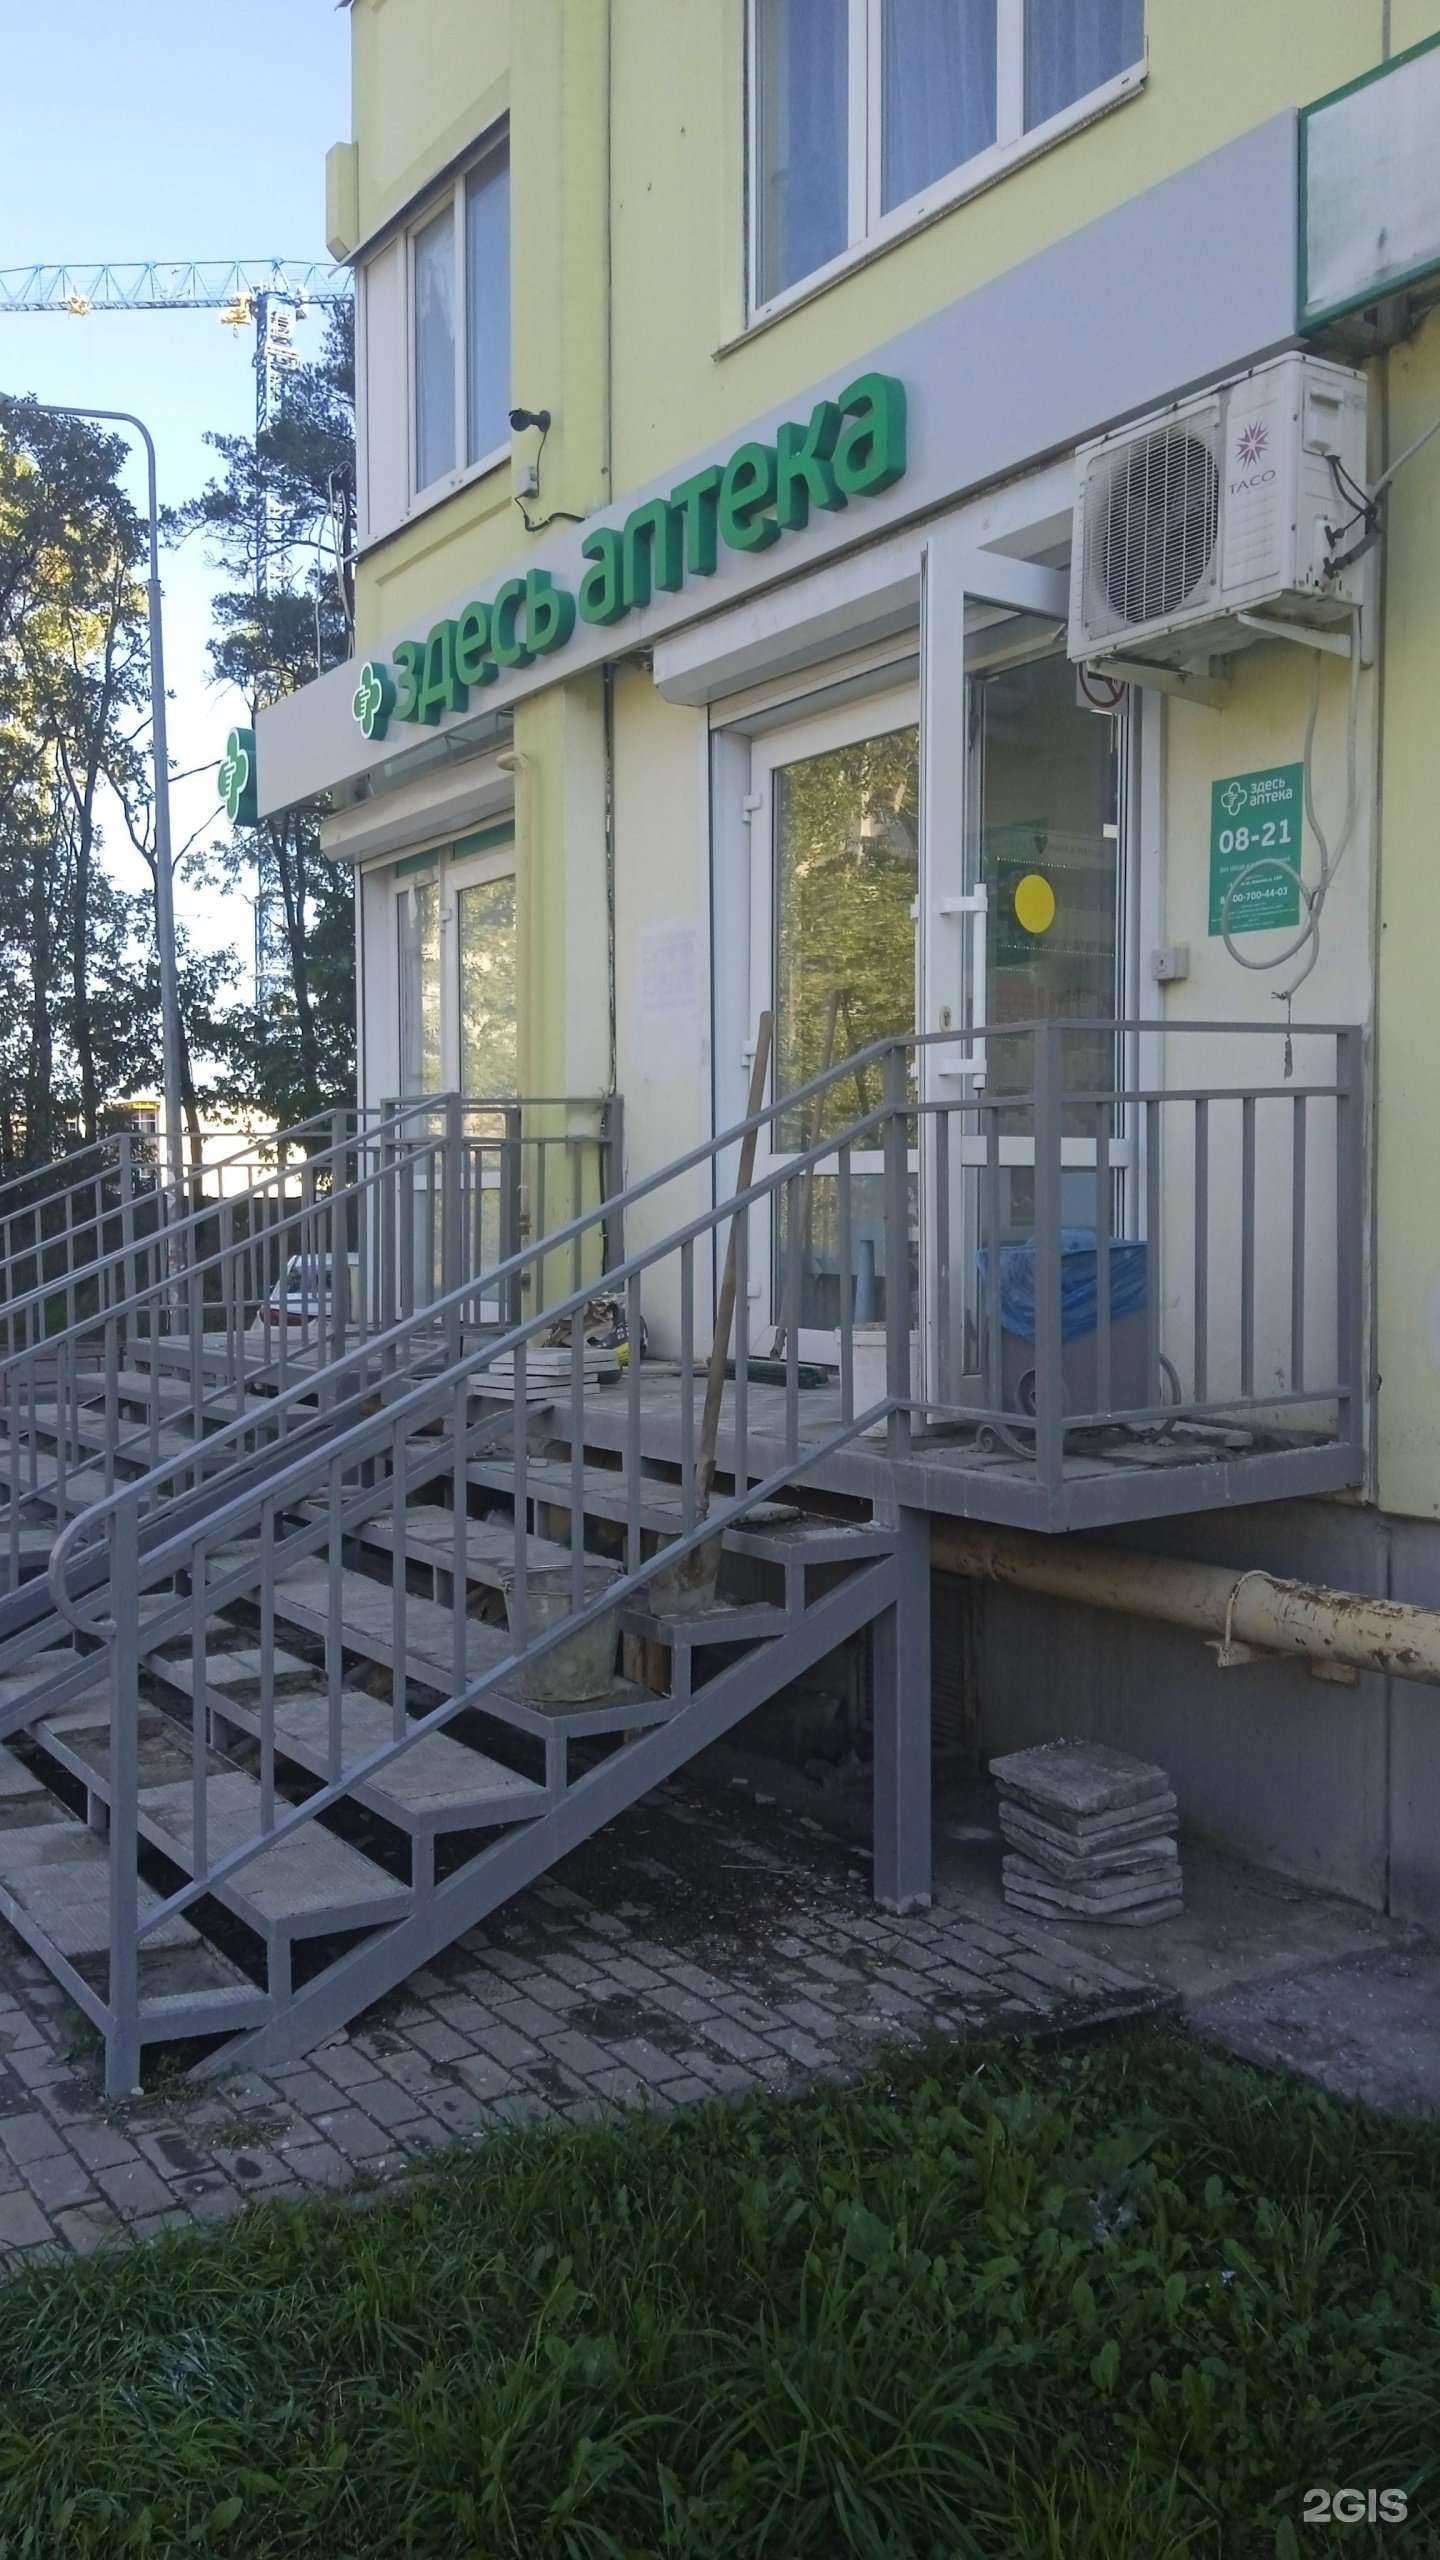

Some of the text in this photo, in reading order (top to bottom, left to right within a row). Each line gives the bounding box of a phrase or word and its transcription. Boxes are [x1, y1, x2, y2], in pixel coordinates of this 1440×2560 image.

[1231, 470, 1276, 495] TACO
[392, 372, 908, 727] здесь аптека
[1249, 778, 1286, 794] здесь
[1249, 788, 1293, 806] аптека
[1219, 818, 1292, 854] 08-21
